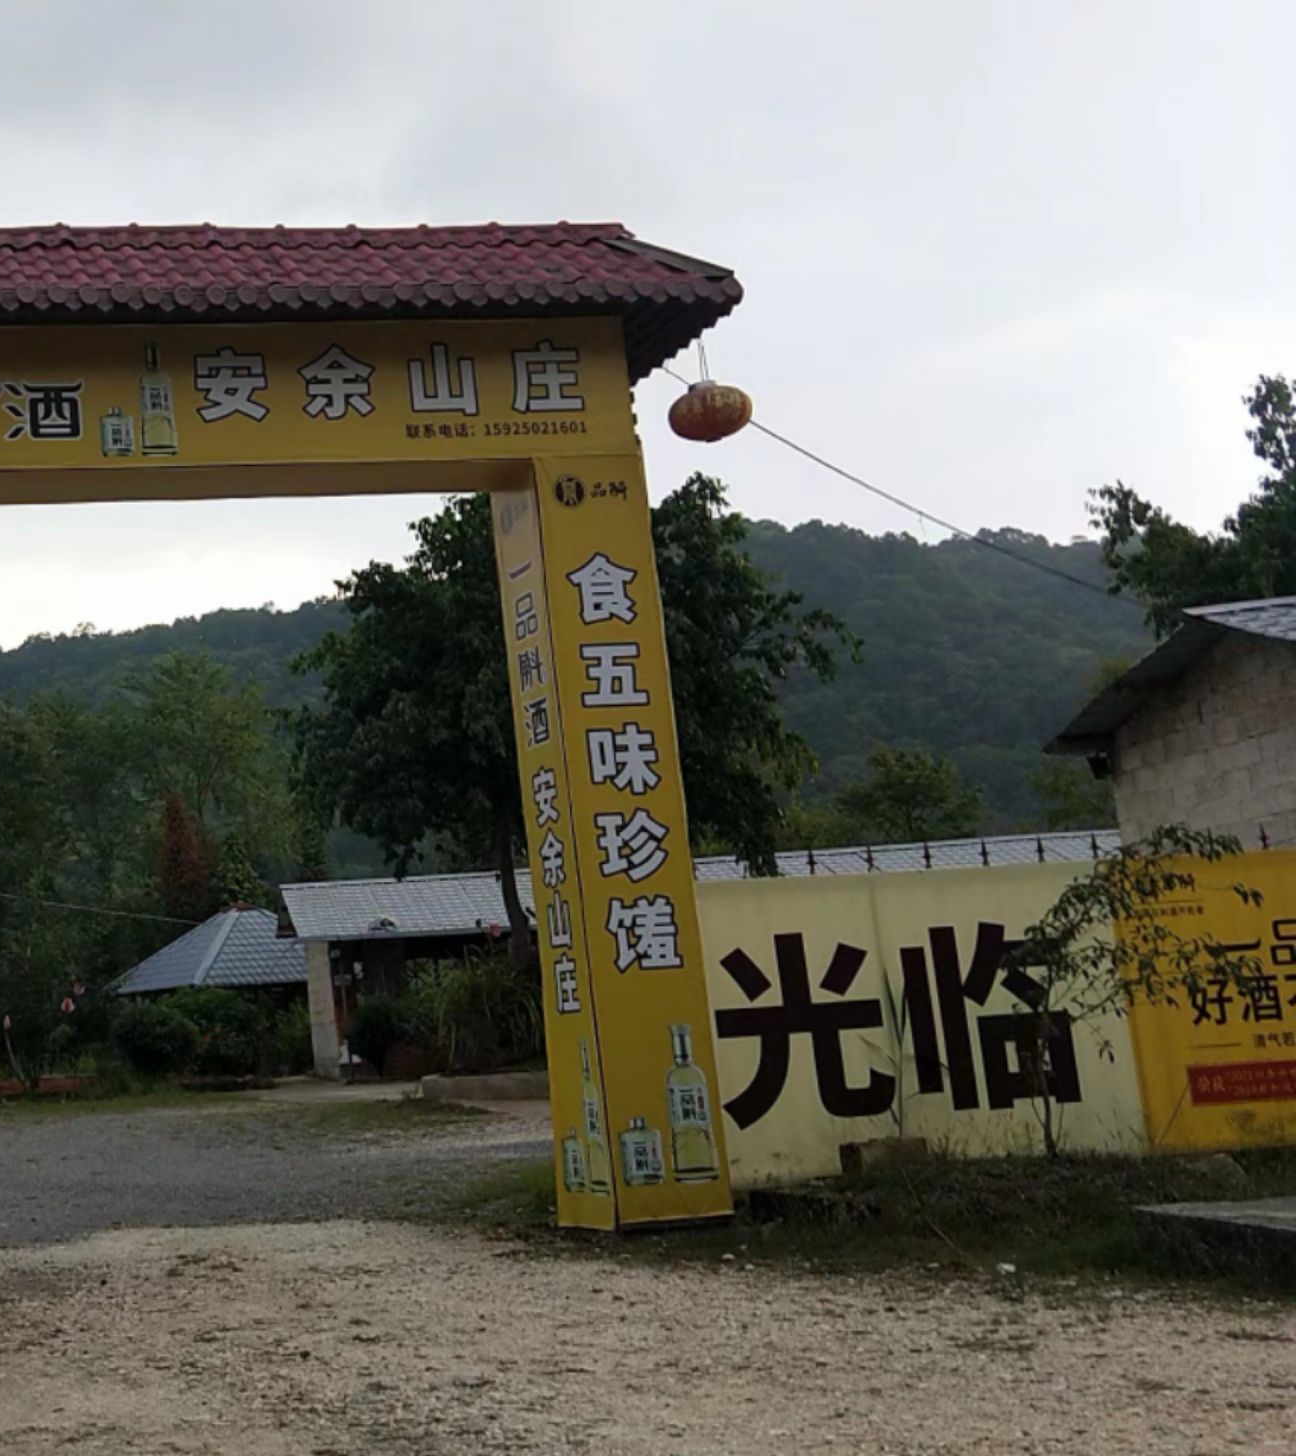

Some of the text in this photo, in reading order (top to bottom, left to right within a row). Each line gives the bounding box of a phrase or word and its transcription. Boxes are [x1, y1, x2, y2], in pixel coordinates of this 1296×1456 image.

[194, 340, 585, 422] 安余山庄
[566, 552, 684, 973] 食五味珍馐
[532, 766, 582, 1015] 安余山庄
[715, 922, 1082, 1130] 光临
